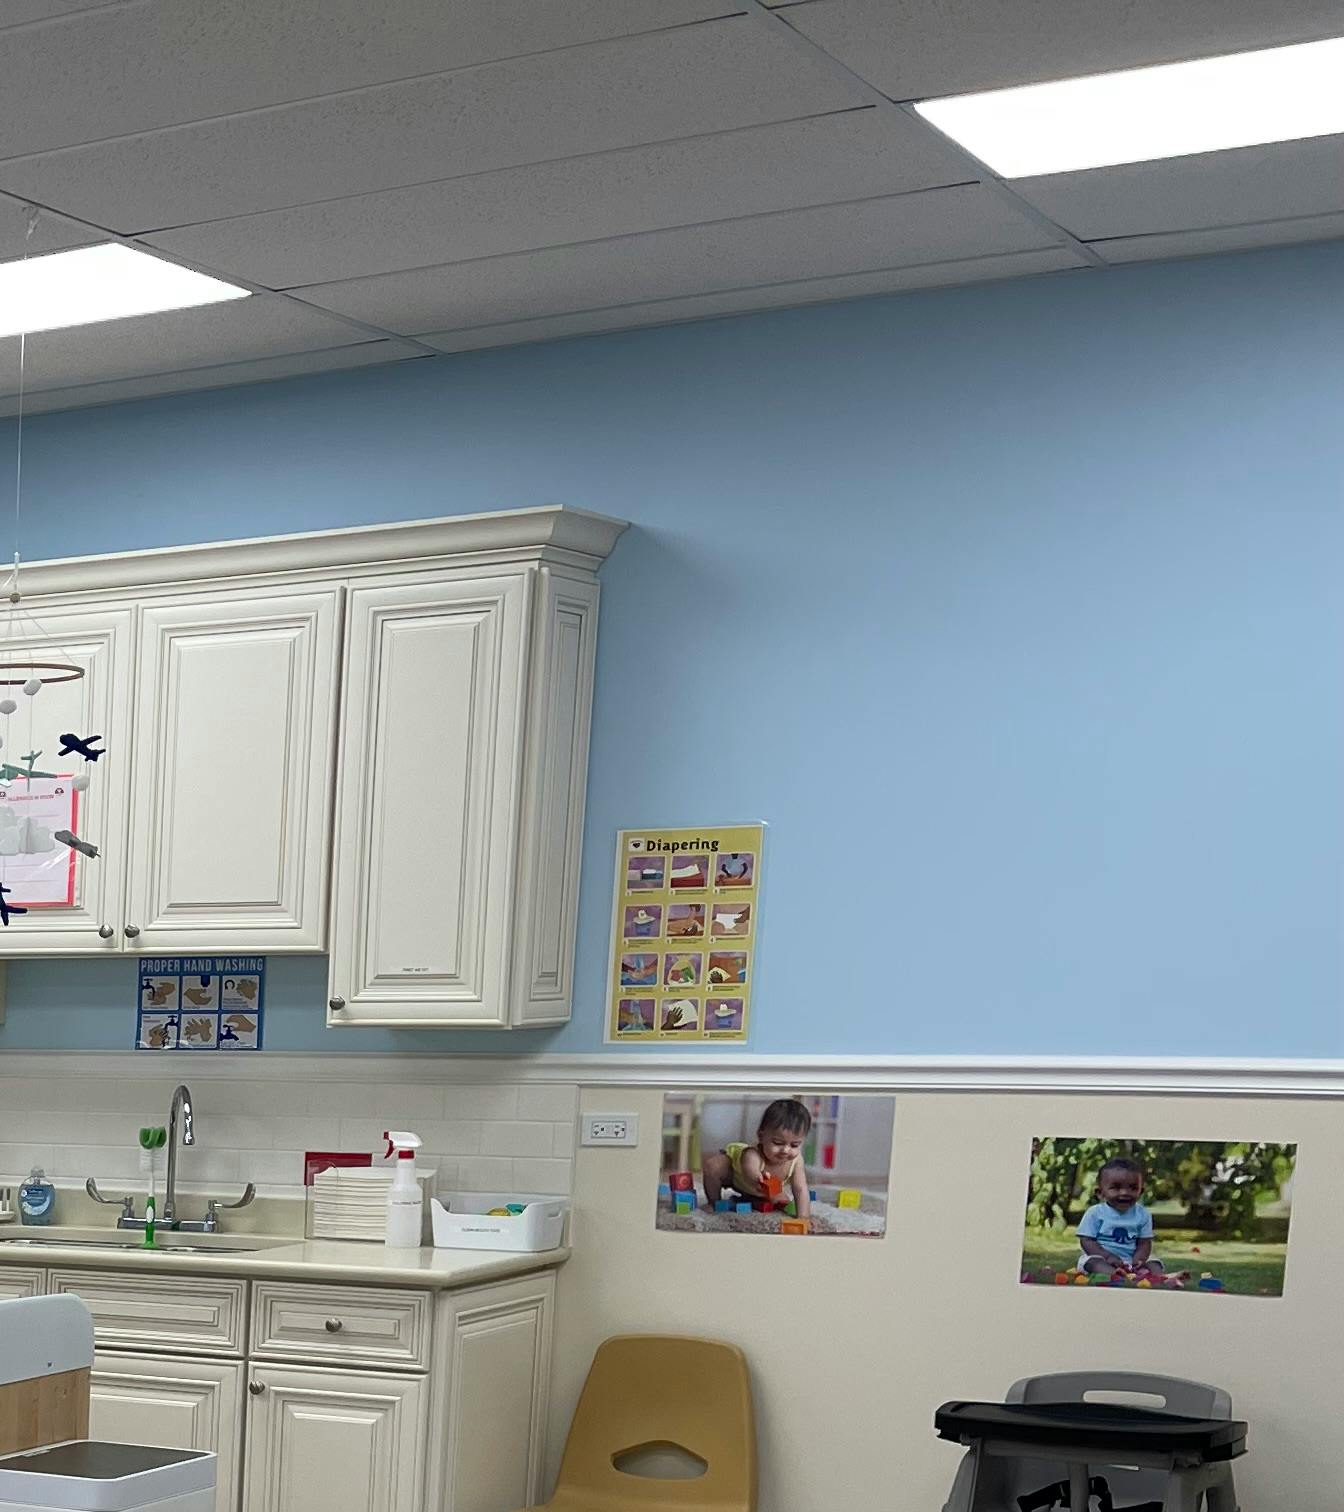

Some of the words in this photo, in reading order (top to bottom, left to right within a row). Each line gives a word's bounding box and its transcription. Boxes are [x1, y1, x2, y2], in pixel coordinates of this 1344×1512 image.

[646, 837, 720, 854] Diapering
[140, 959, 180, 973] PROPER
[183, 959, 212, 972] HAND
[215, 958, 263, 971] WASHING
